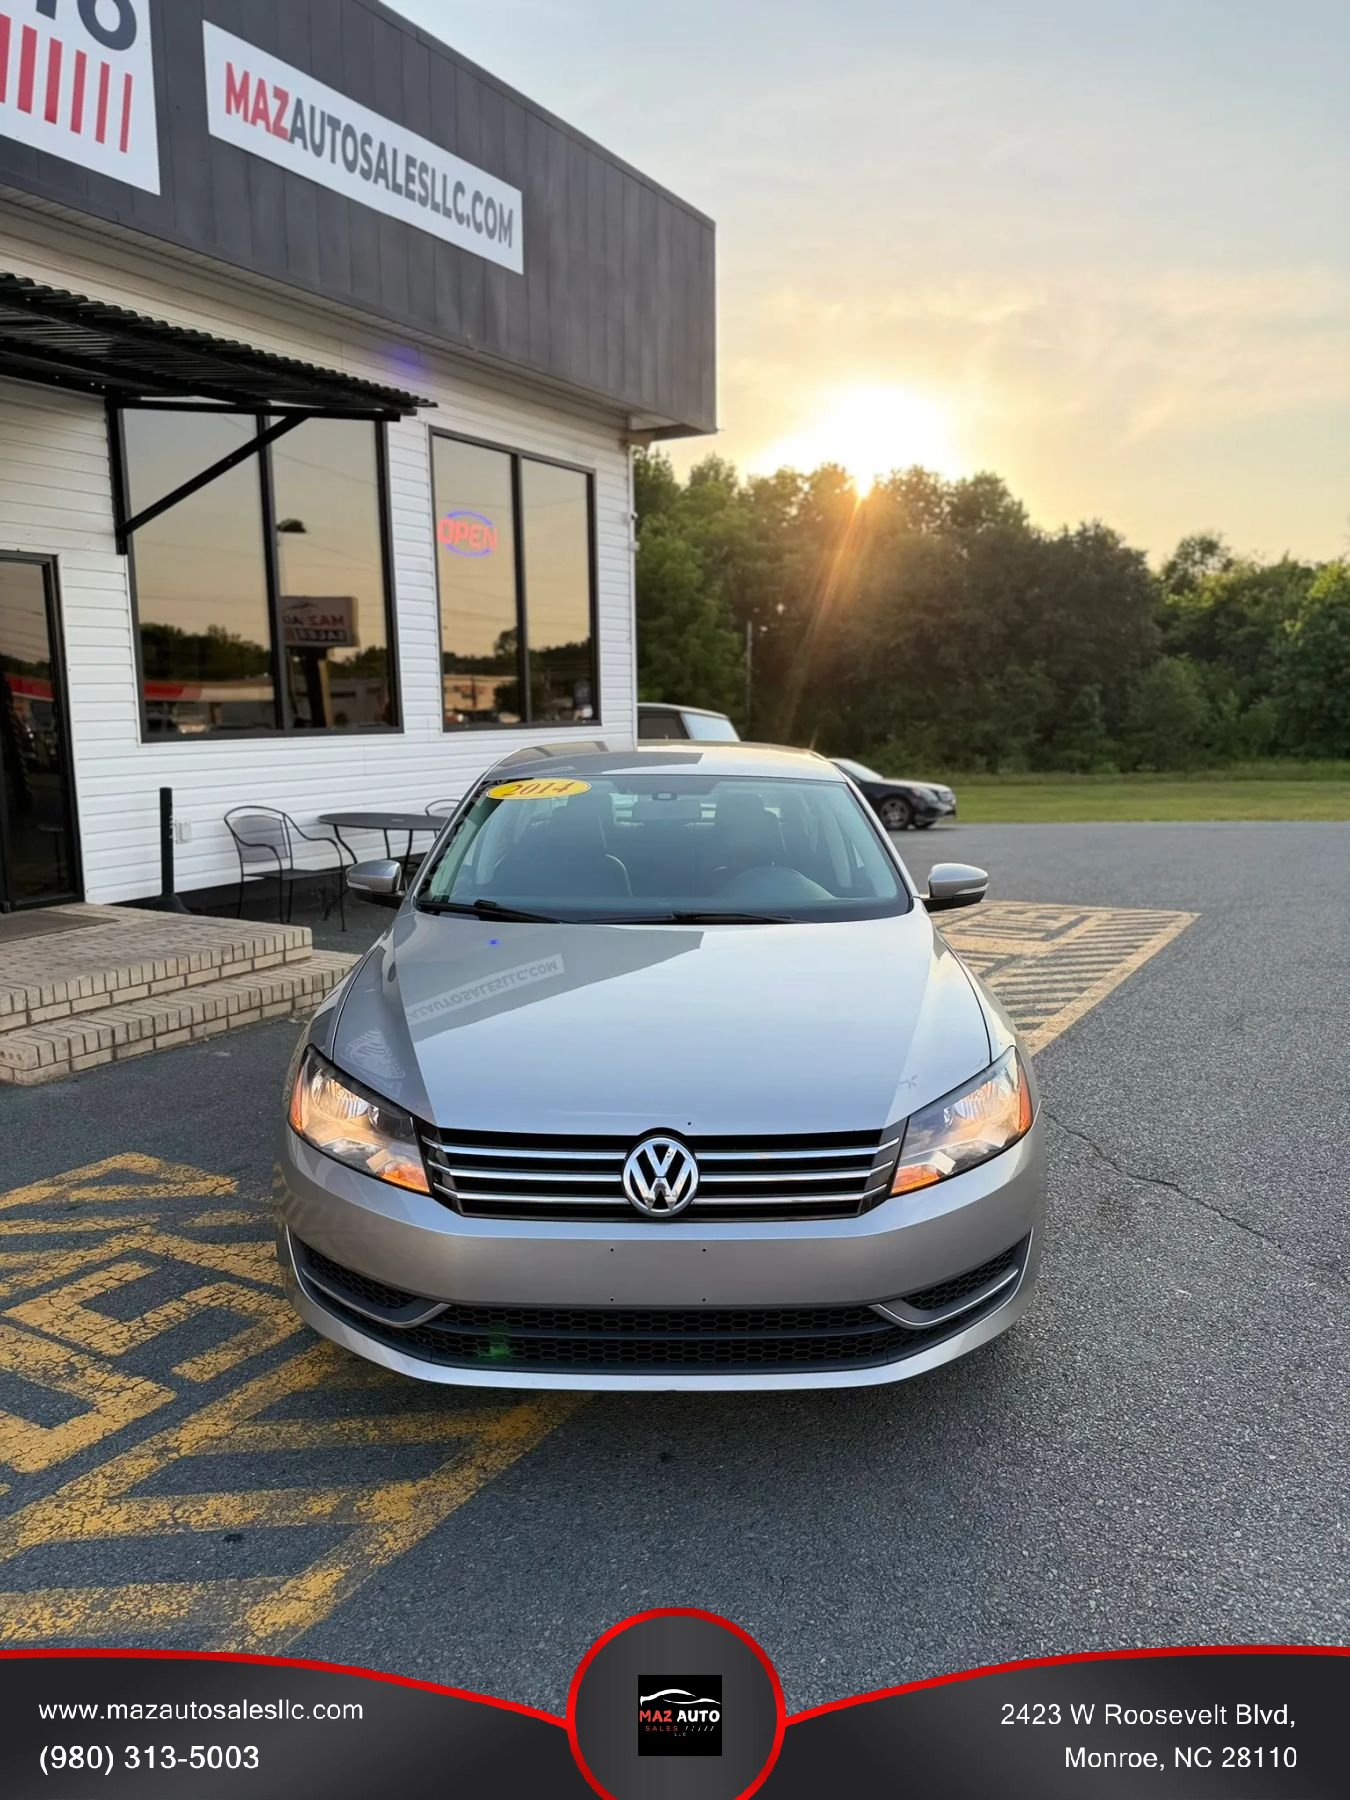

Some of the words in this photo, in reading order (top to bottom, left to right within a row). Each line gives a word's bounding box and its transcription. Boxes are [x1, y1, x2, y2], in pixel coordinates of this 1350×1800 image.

[225, 61, 514, 249] MAZAUTOSALESLLC.COM
[438, 518, 497, 551] OPEN
[501, 782, 577, 797] 2014
